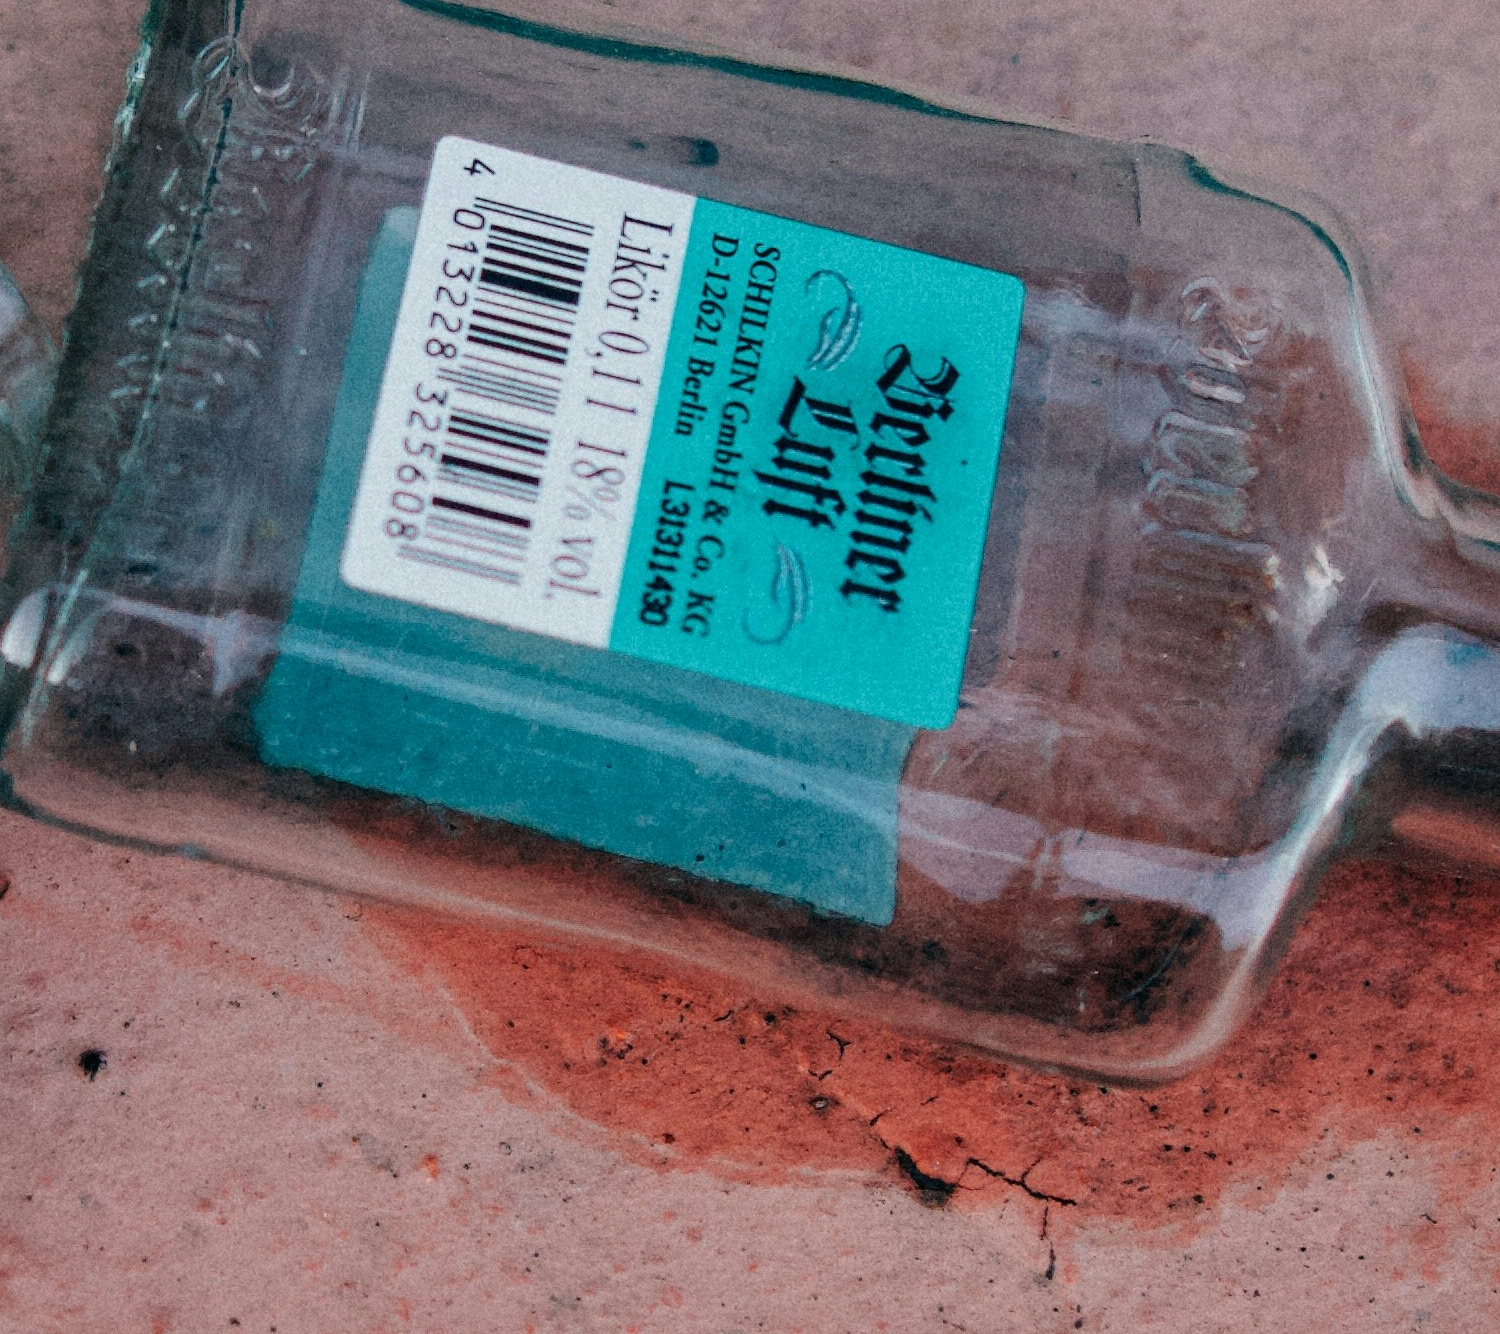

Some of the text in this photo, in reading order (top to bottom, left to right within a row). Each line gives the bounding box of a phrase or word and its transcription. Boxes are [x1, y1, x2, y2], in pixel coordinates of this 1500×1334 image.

[385, 157, 496, 540] 4 013228 325608
[606, 214, 674, 321] Likör
[675, 233, 739, 436] D-12621 Berlin
[567, 440, 628, 519] 18%
[681, 243, 780, 635] SCHILKIN GmbH & Co. KG
[754, 377, 858, 528] Luft
[840, 344, 959, 612] Berliner
[543, 535, 603, 601] vol.
